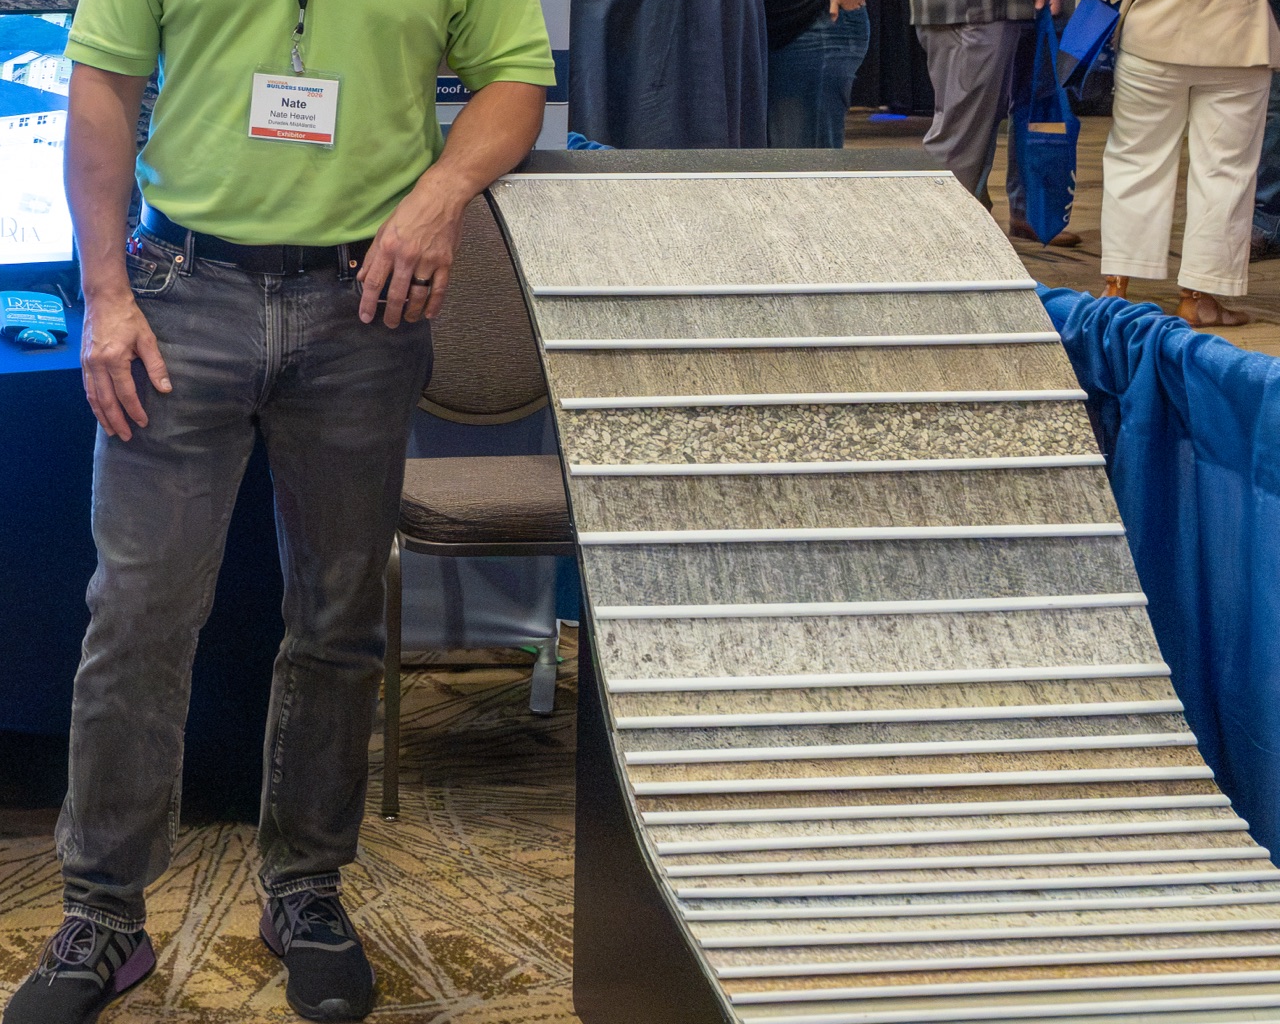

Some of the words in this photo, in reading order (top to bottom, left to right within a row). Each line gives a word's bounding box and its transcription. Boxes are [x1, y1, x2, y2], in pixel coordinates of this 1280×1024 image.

[266, 83, 297, 91] BUILDERS
[281, 98, 307, 109] Nate
[270, 110, 288, 119] Nate
[290, 112, 316, 121] Heavel
[277, 130, 306, 139] Exhibitor
